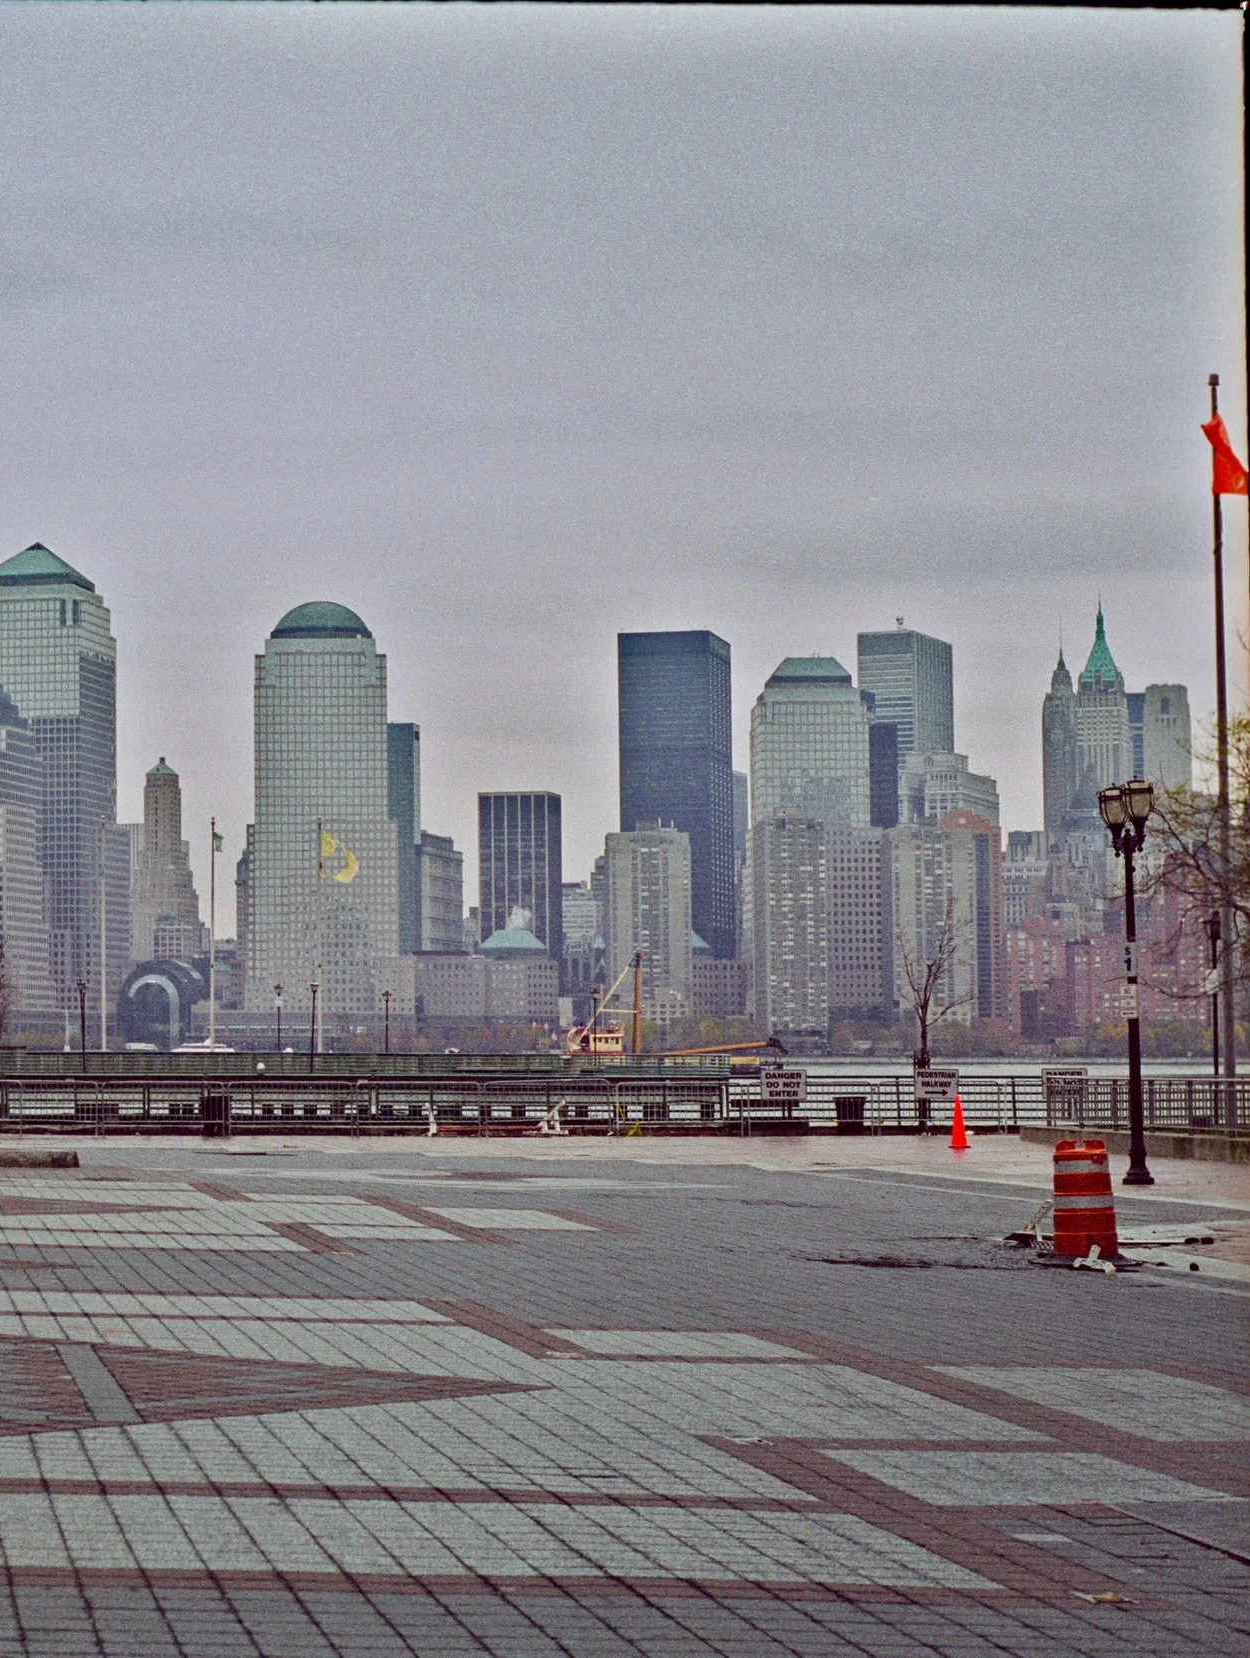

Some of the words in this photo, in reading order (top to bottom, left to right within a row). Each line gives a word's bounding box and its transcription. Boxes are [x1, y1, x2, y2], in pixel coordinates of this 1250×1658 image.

[1124, 946, 1131, 956] S
[1124, 957, 1132, 972] 1
[765, 1072, 802, 1080] DANGER
[916, 1071, 956, 1079] PEDESTRIAN
[766, 1081, 780, 1089] DO
[783, 1081, 801, 1089] NOT
[921, 1080, 952, 1088] WALKWAY
[769, 1090, 799, 1098] ENTER
